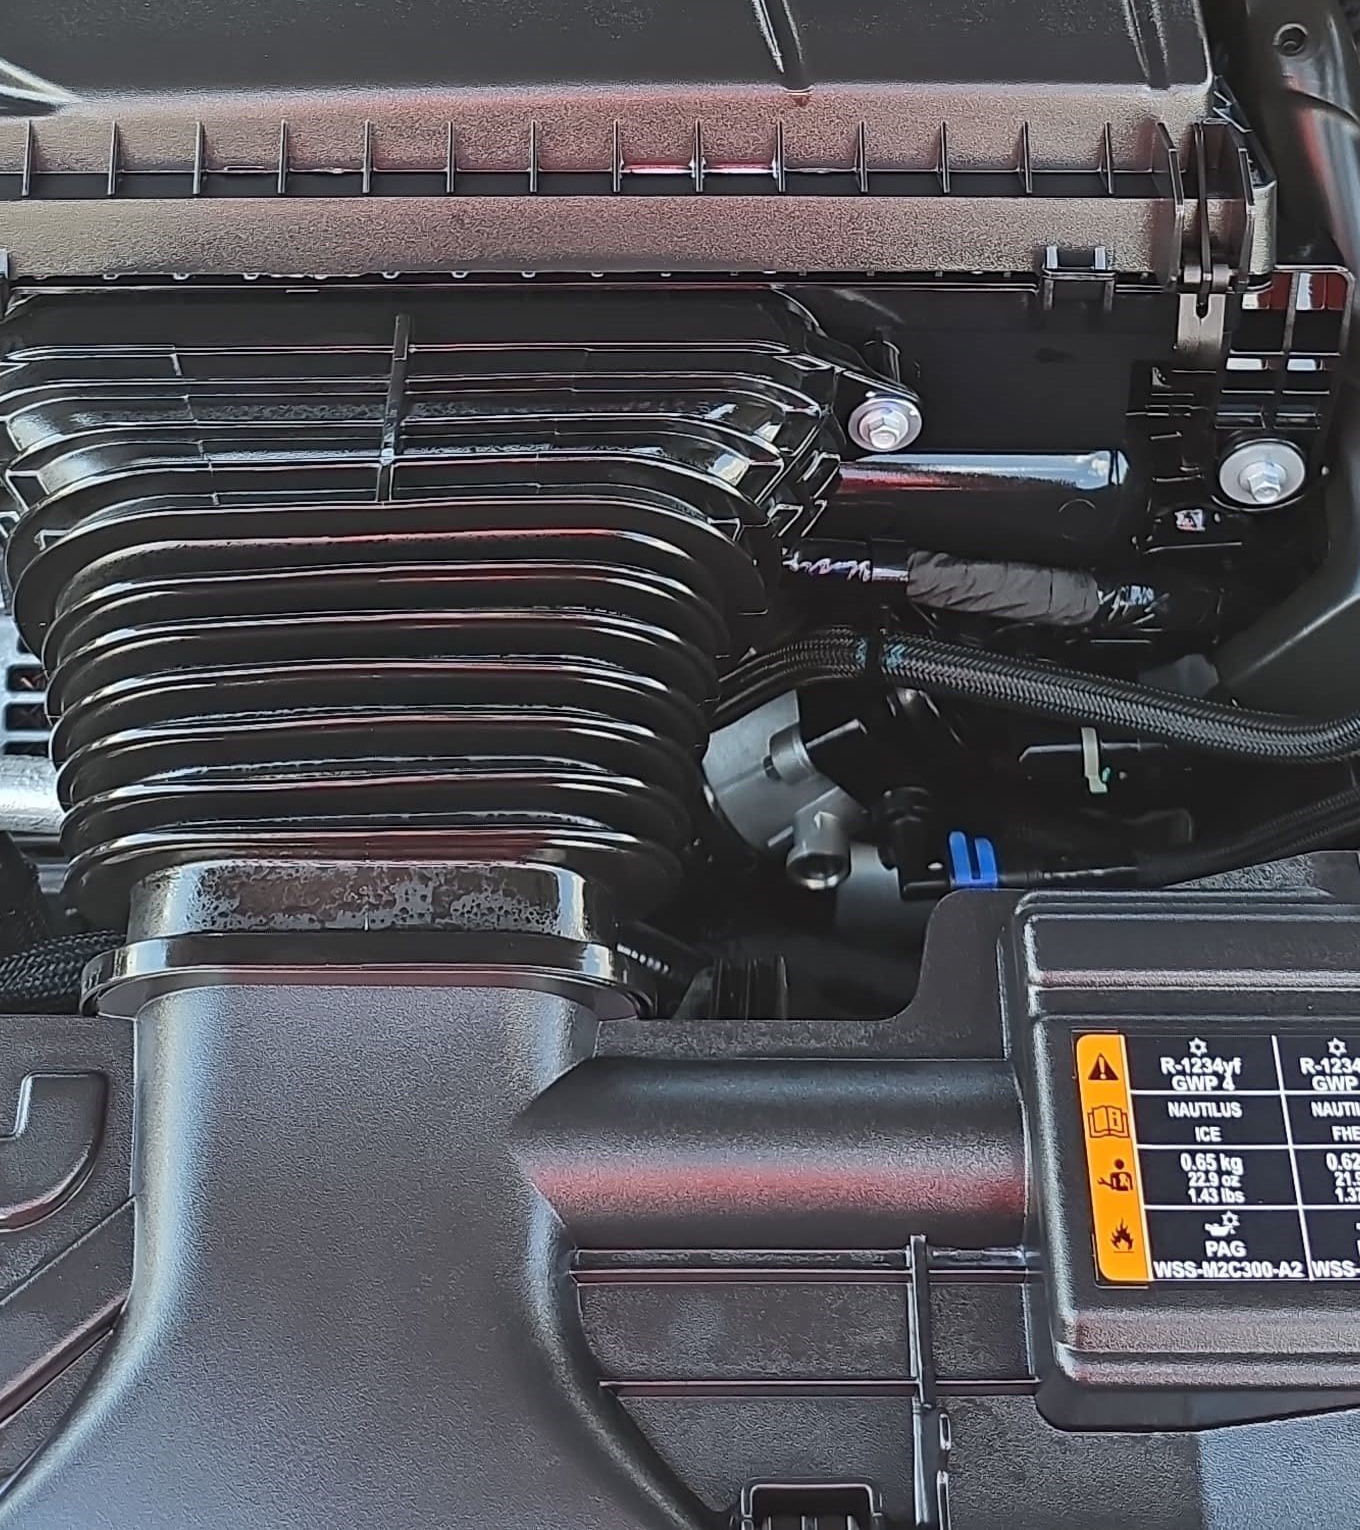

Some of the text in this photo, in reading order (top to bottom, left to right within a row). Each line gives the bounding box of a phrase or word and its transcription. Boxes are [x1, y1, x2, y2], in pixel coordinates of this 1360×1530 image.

[1161, 1058, 1241, 1076] R-1234yf
[1172, 1074, 1235, 1091] GWP 4
[1312, 1076, 1360, 1091] GWP
[1168, 1102, 1242, 1117] NAUTILUS
[1195, 1127, 1221, 1142] ICE
[1181, 1153, 1243, 1174] 0.65 kg
[1327, 1153, 1359, 1171] 0.62
[1188, 1172, 1242, 1187] 22.9 oz
[1188, 1188, 1245, 1203] 1.43 lbs
[1206, 1241, 1246, 1257] PAG
[1153, 1261, 1304, 1279] WSS-M2C300-A2
